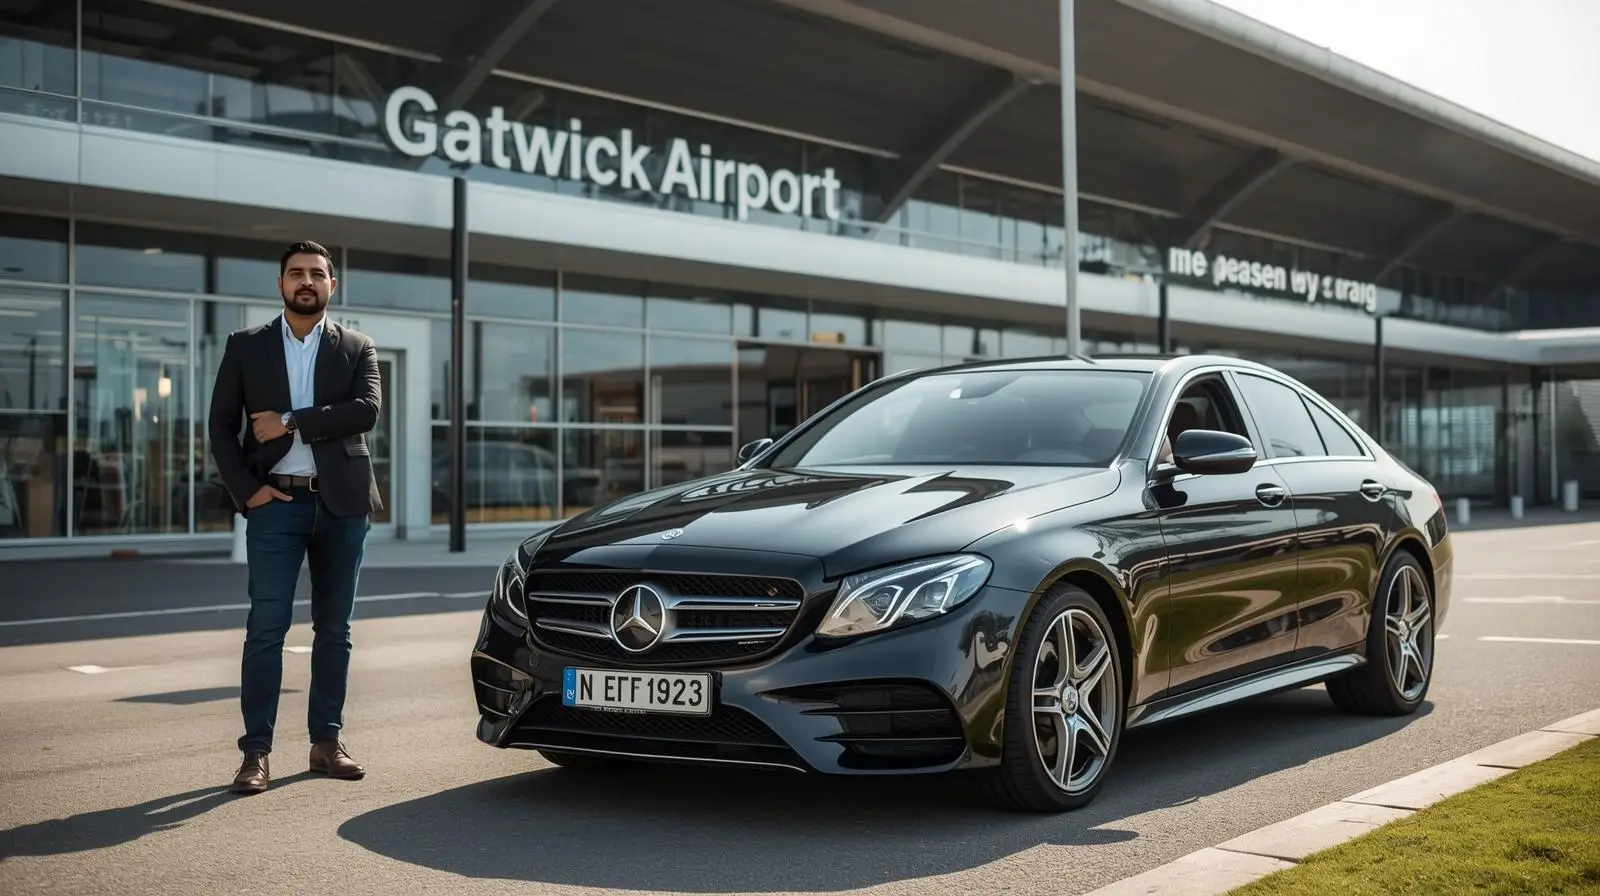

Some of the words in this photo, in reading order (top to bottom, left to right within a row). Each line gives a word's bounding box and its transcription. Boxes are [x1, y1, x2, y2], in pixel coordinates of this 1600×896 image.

[385, 85, 653, 192] Gatwick
[659, 137, 841, 222] Airport
[580, 674, 593, 701] N
